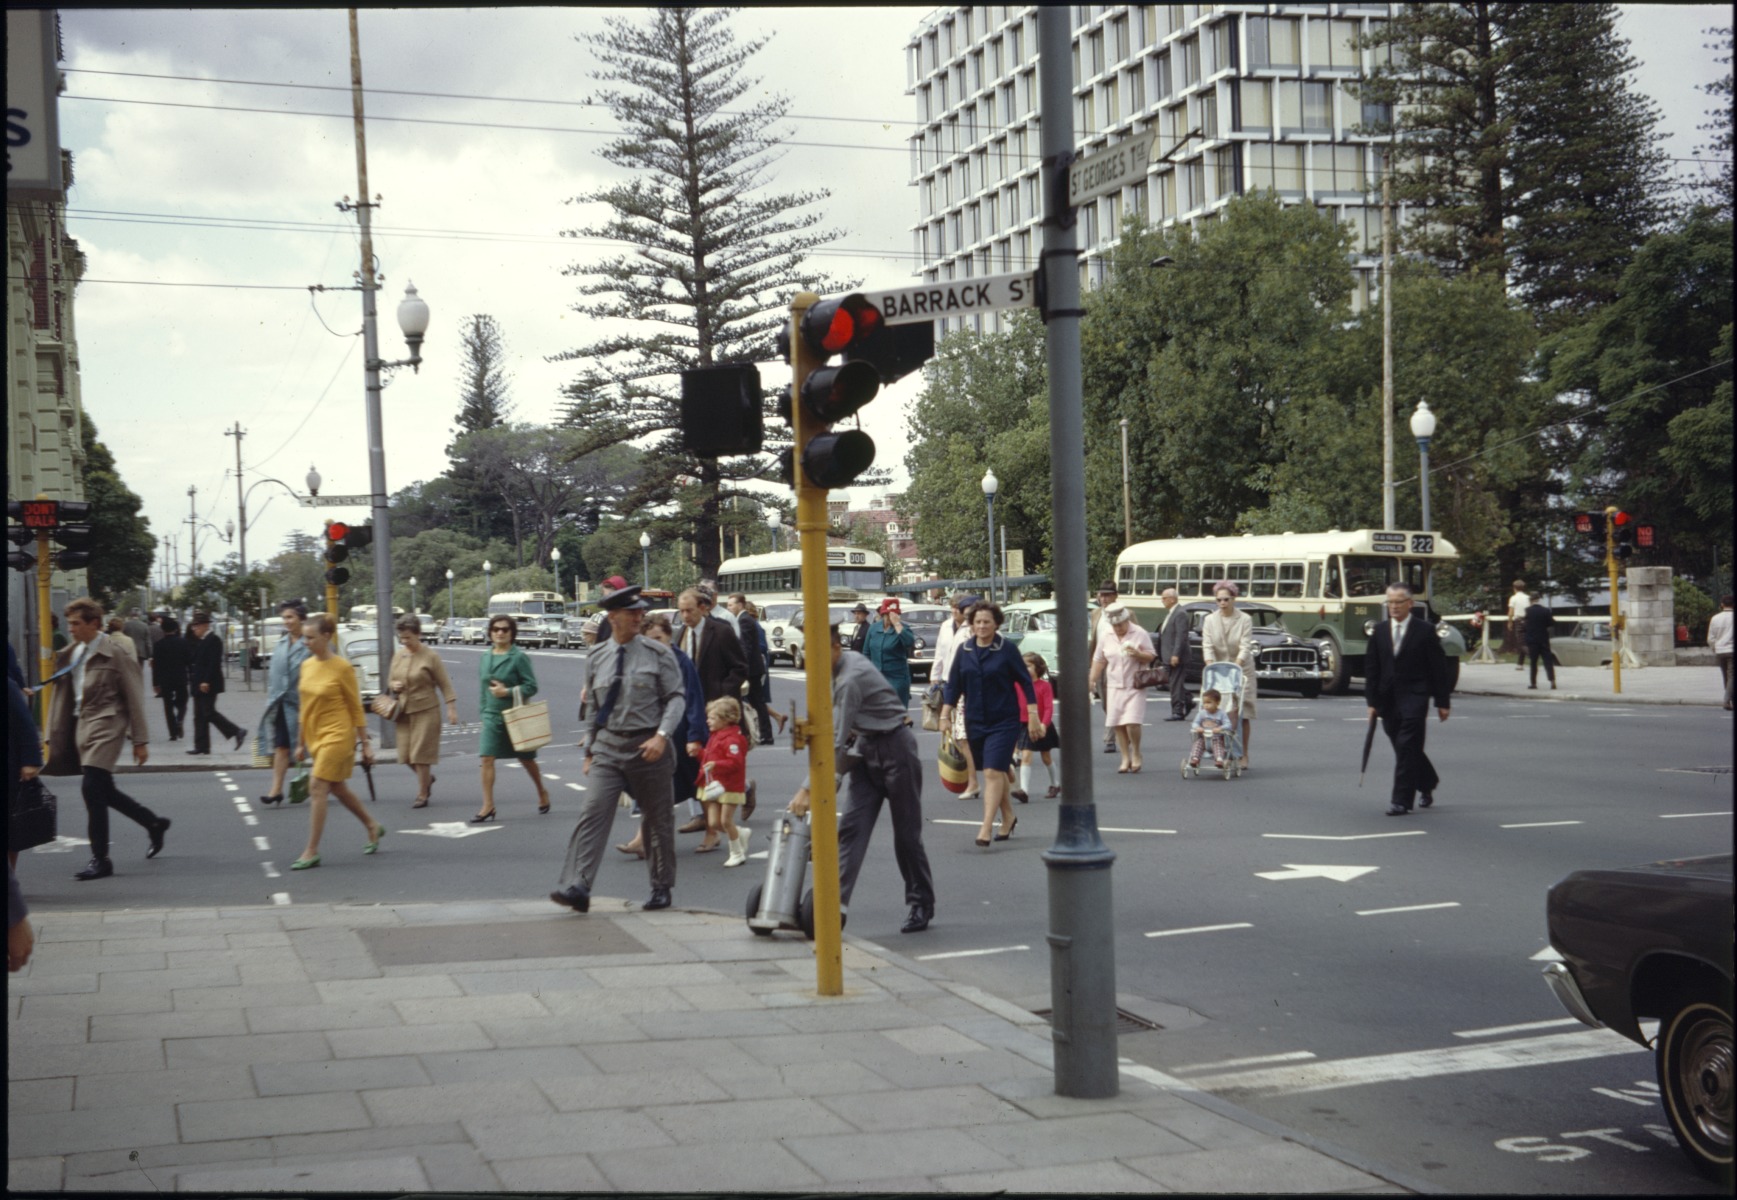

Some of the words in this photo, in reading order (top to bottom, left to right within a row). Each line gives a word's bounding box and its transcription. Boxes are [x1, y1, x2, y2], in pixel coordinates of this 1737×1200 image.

[882, 282, 992, 318] BARRACK
[1008, 277, 1033, 302] ST
[1411, 537, 1433, 552] 222
